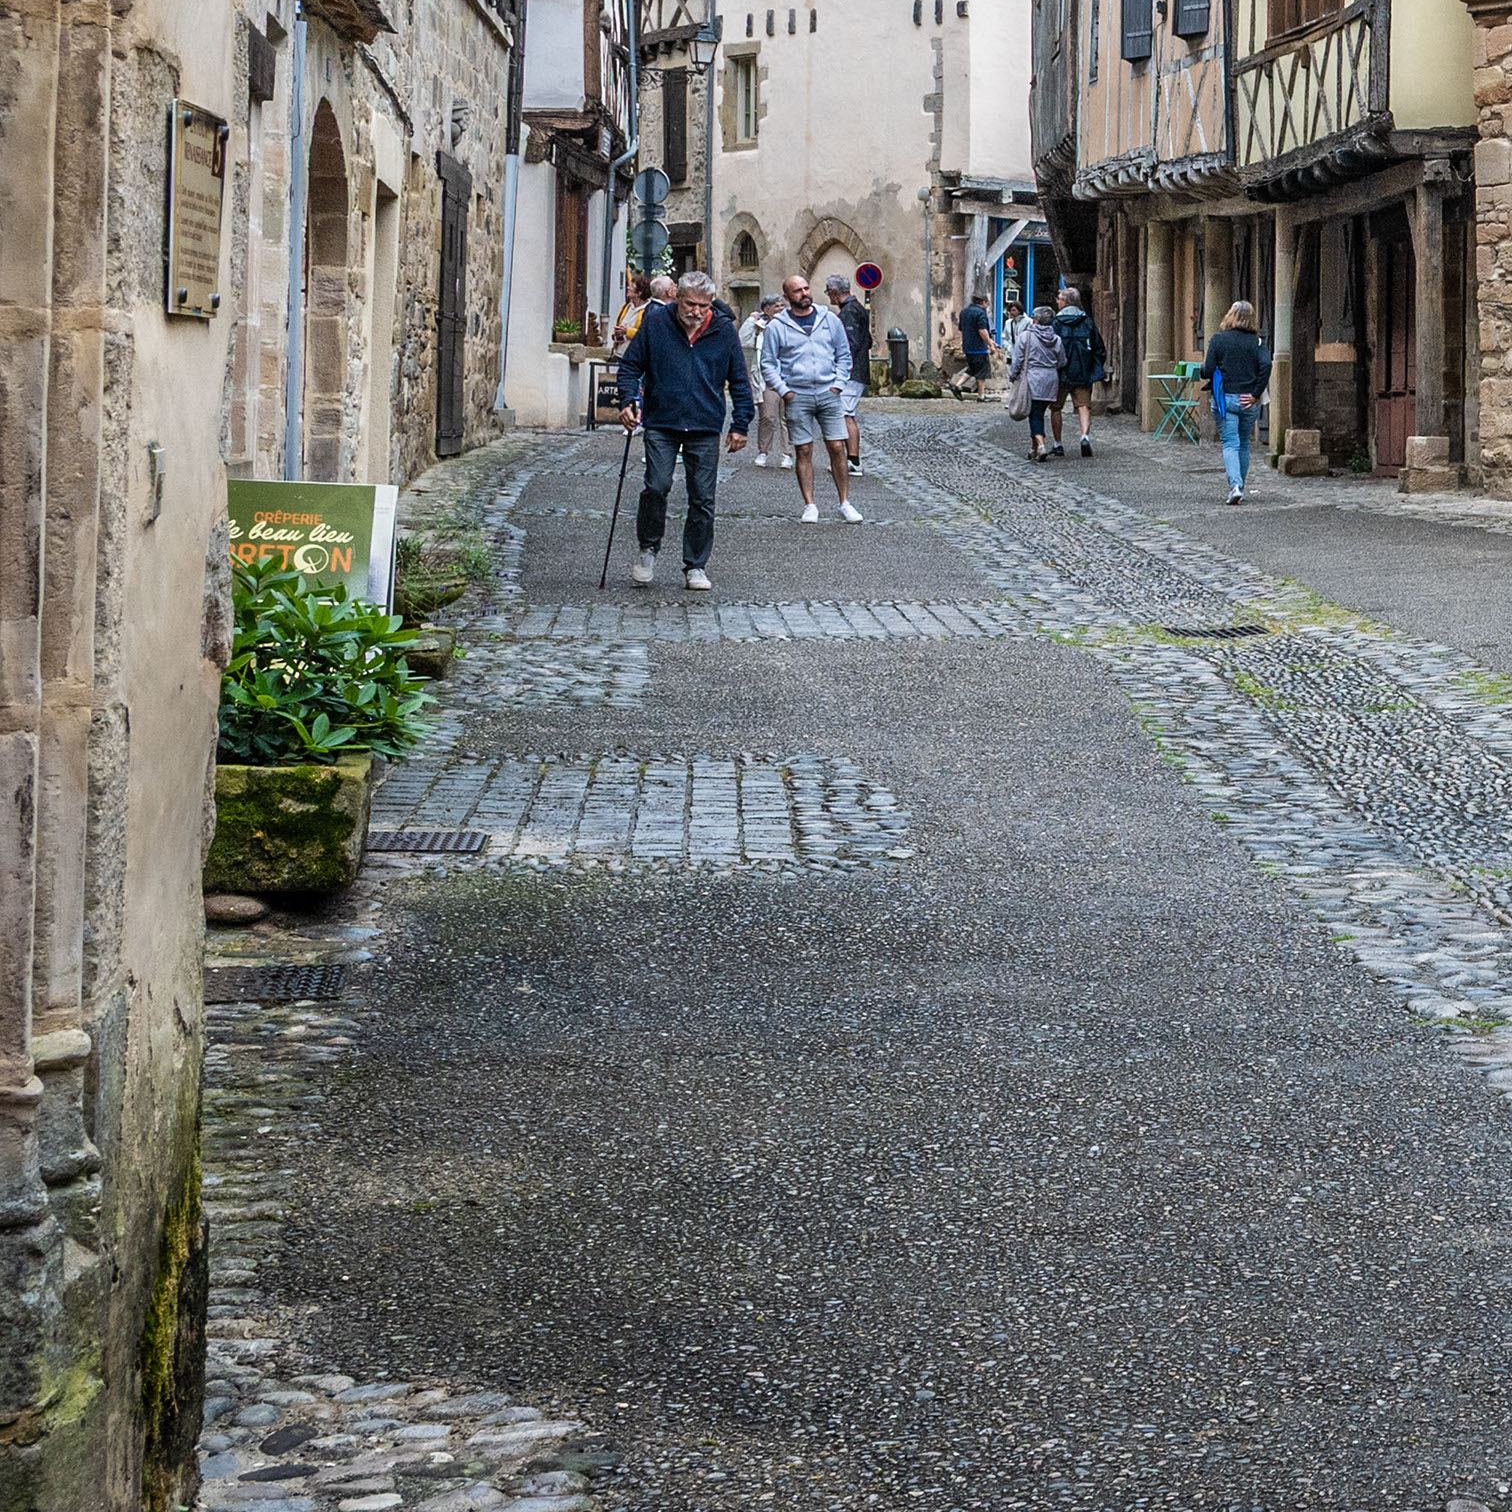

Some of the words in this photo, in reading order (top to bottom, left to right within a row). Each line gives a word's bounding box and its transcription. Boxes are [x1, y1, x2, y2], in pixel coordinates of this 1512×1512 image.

[254, 509, 323, 526] CRÊPERIE
[248, 521, 304, 542] beau
[309, 523, 354, 543] lieu
[229, 543, 353, 574] RETON
